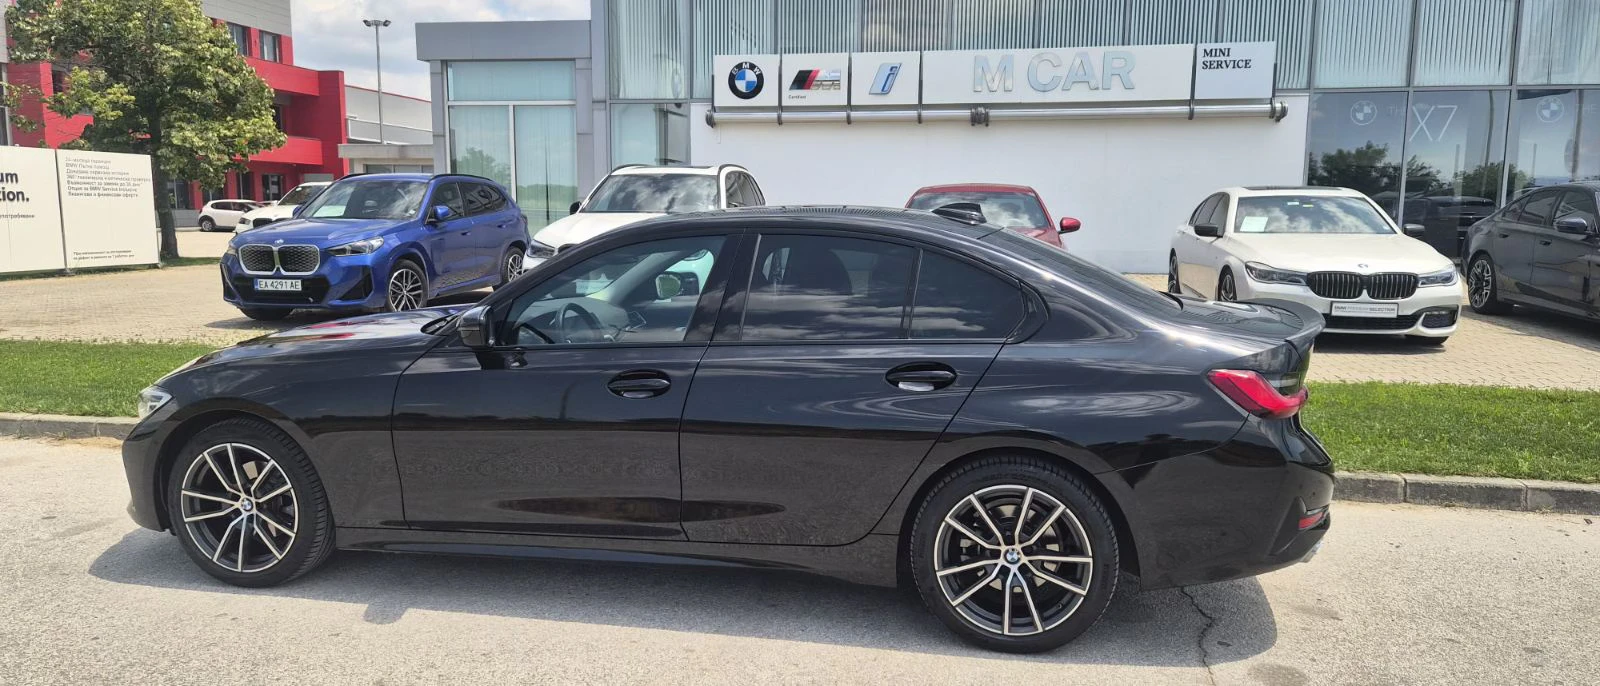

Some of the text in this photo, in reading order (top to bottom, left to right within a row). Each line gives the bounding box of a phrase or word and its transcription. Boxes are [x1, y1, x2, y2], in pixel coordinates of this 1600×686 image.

[1203, 48, 1231, 57] MINI
[731, 62, 762, 75] BMW
[1202, 59, 1252, 69] SERVICE
[973, 51, 1136, 93] M CAR
[1409, 105, 1458, 142] X7
[0, 187, 30, 202] ion.
[259, 281, 300, 289] EA 4291 AE
